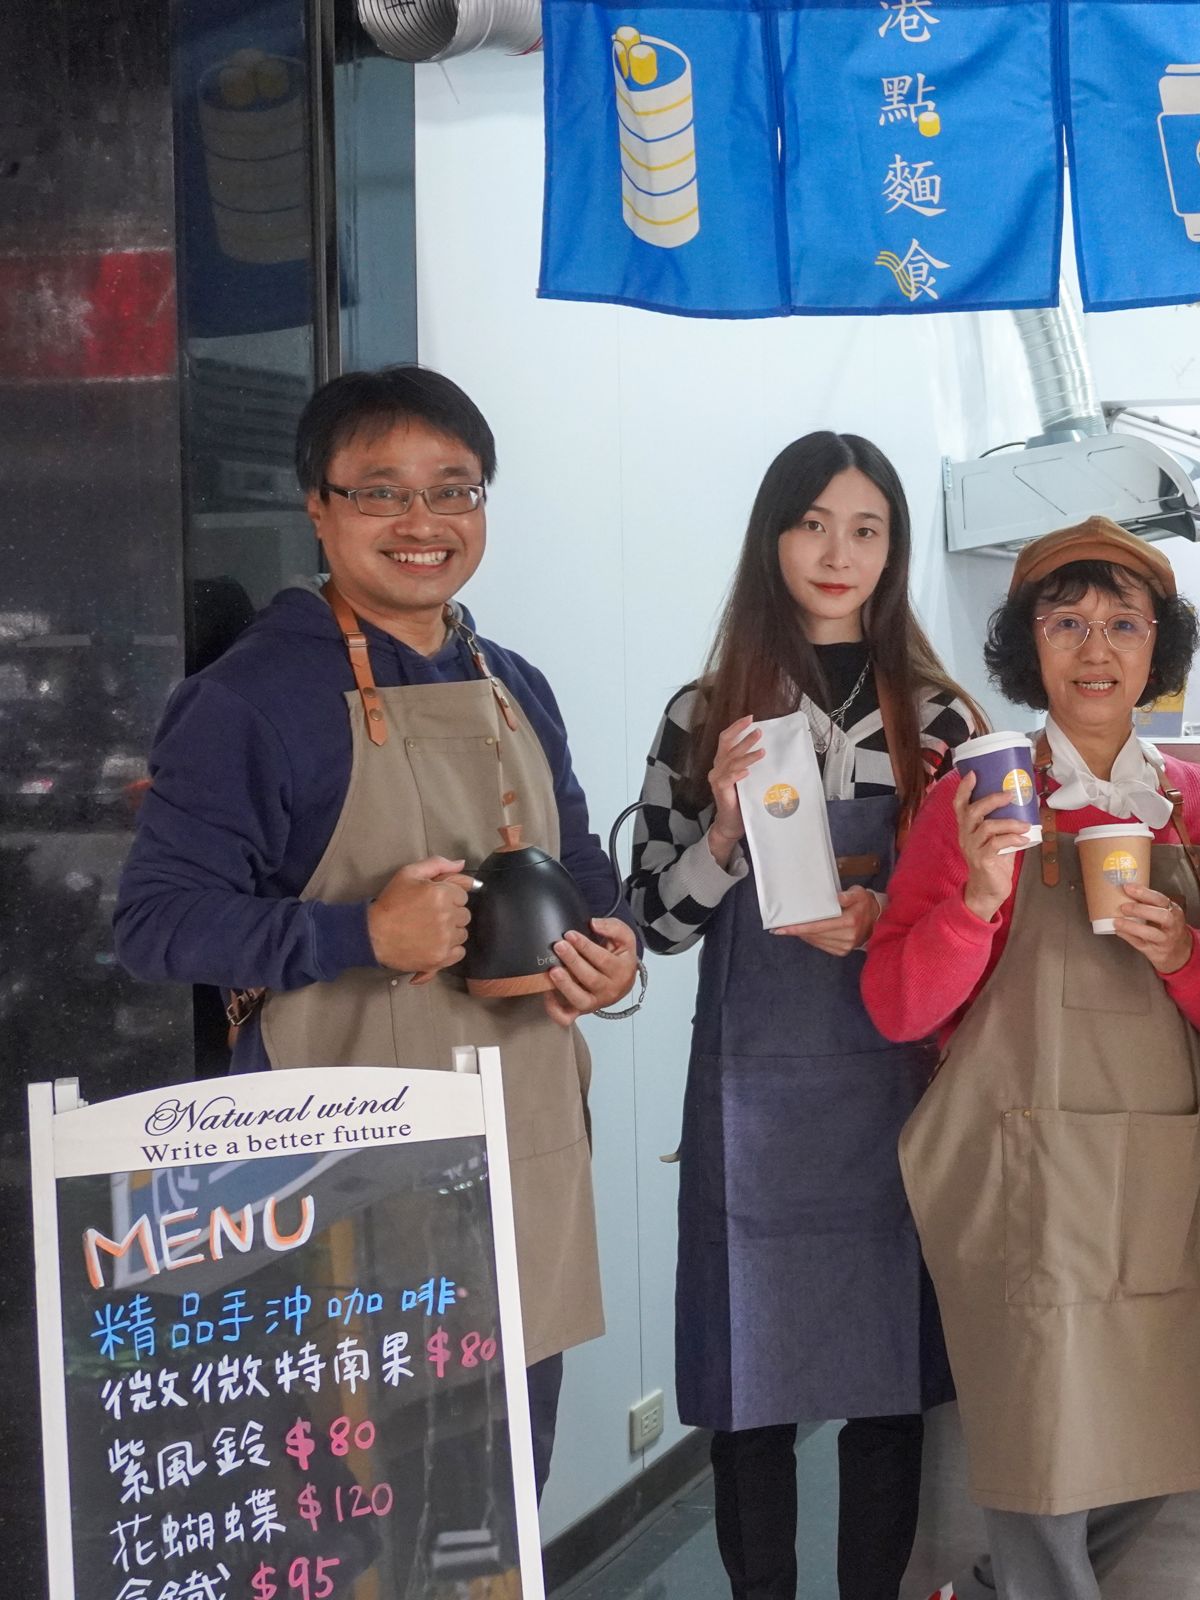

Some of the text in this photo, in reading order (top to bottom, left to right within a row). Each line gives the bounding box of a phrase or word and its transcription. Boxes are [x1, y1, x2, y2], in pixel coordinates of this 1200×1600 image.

[141, 1123, 412, 1164] Write a better future
[144, 1085, 409, 1137] Natural wind
[83, 1195, 315, 1290] MENU
[90, 1277, 456, 1361] 精品手沖咖啡
[108, 1420, 271, 1504] 紫風鈴
[110, 1488, 287, 1572] 花蝴蝶
